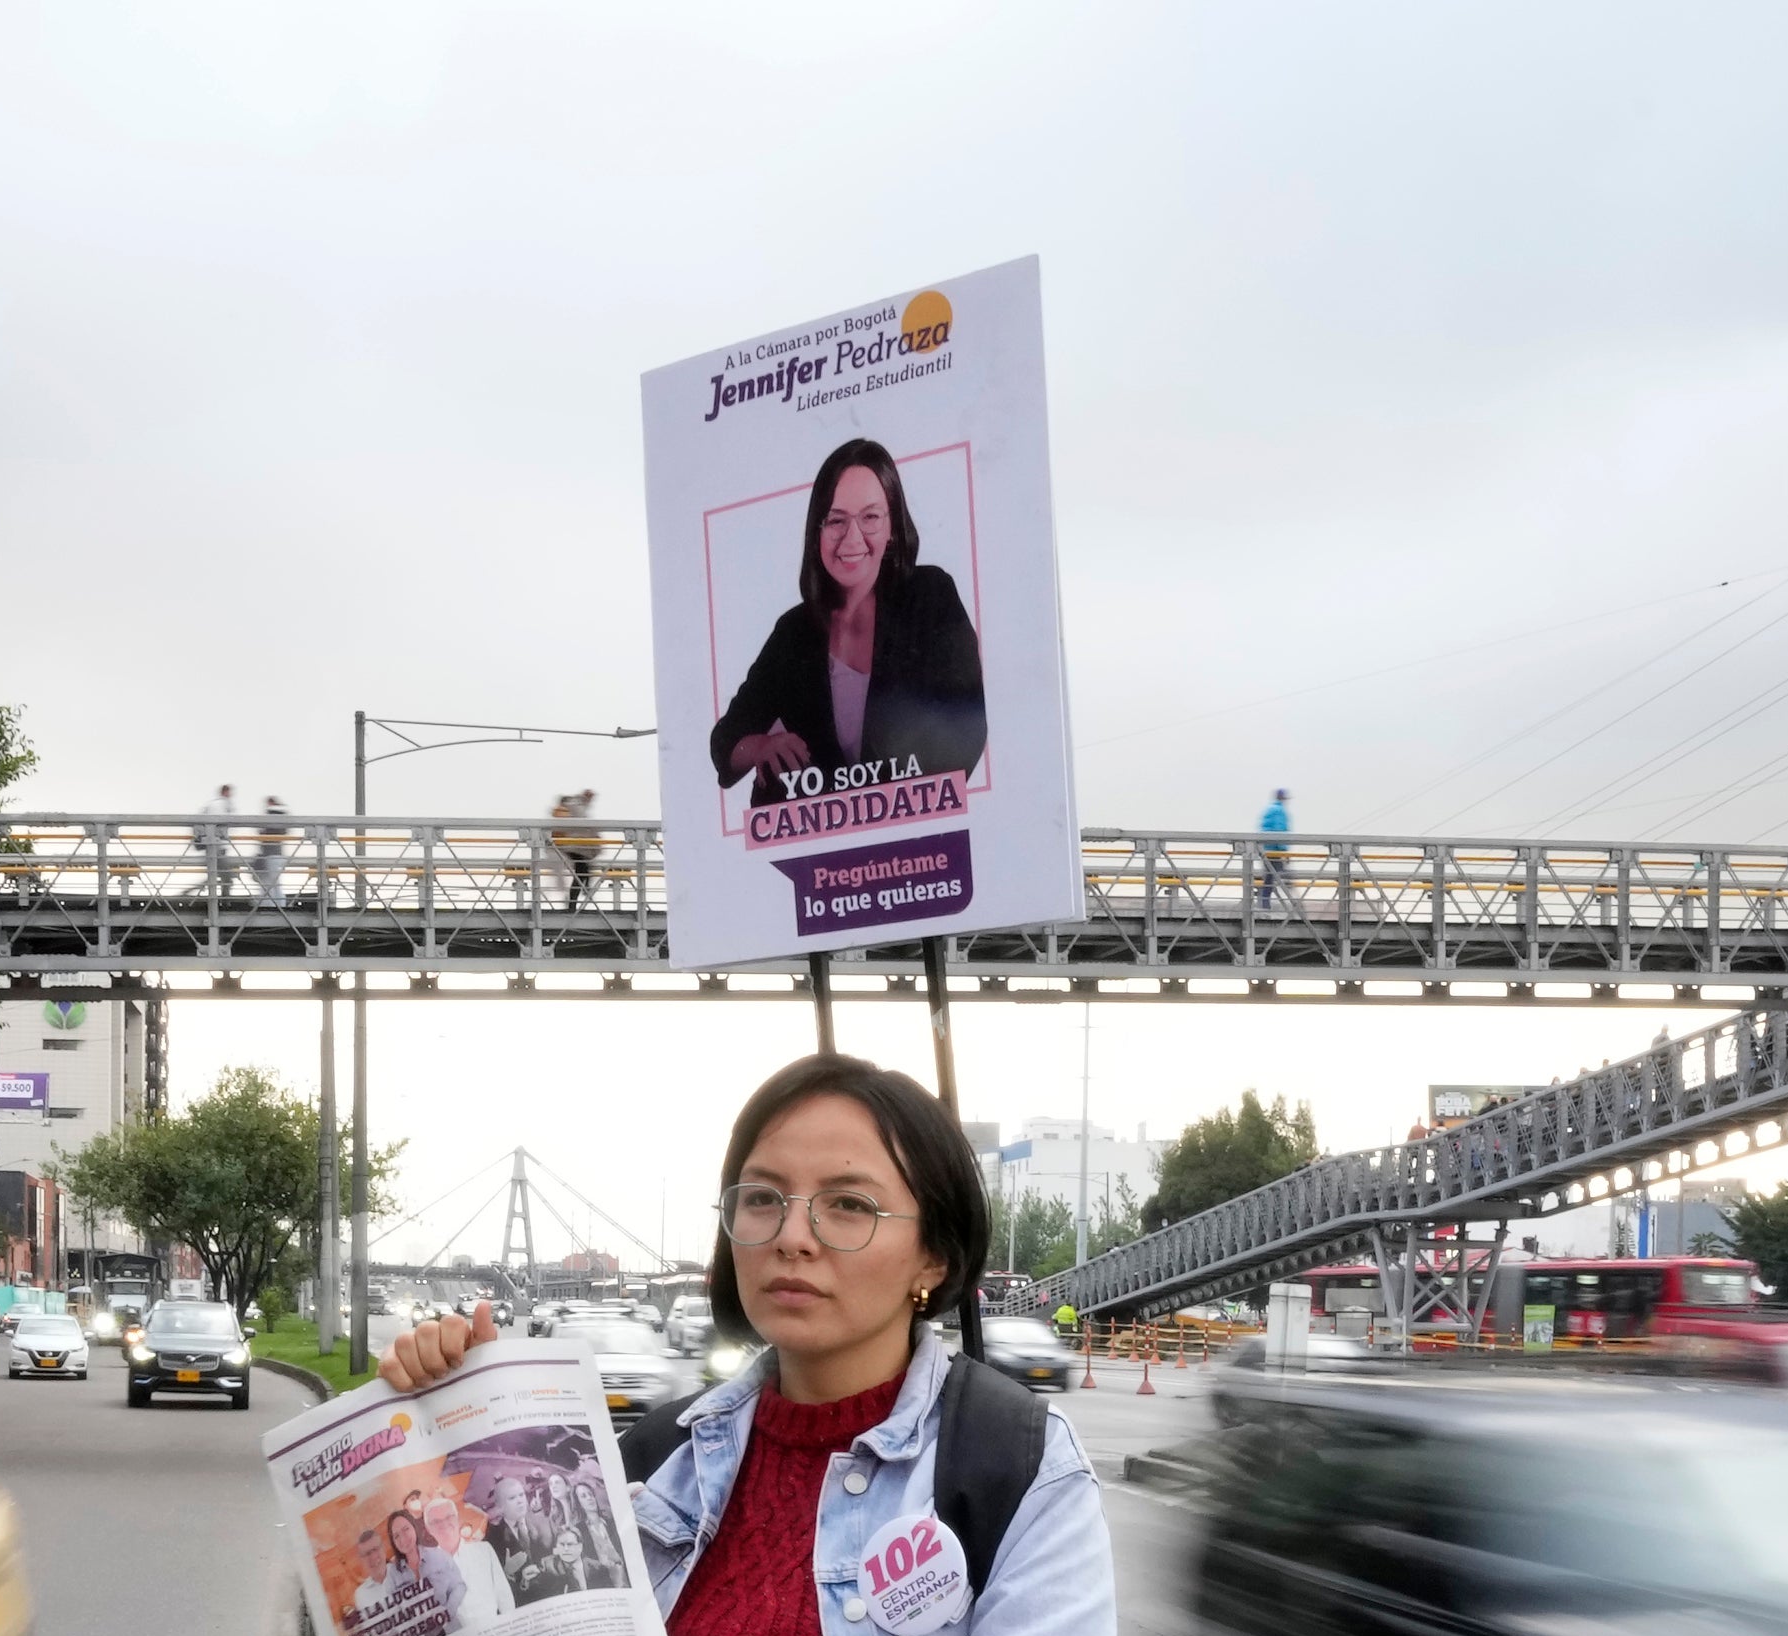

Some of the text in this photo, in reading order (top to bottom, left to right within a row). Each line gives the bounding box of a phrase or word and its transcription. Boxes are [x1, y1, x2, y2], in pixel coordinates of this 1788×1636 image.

[725, 304, 897, 370] A la Cámara por Bogotá
[704, 320, 950, 422] Jennifer Pedraza
[796, 352, 953, 412] Lideresa Estudiantil
[779, 754, 923, 800] YO SOY LA
[750, 778, 962, 843] CANDIDATA
[813, 852, 949, 890] Pregúntame
[803, 878, 963, 918] lo que quieras
[341, 1424, 406, 1480] DIGNA
[864, 1517, 943, 1597] 102
[365, 1601, 385, 1620] LA
[385, 1576, 434, 1610] LUCHA
[881, 1570, 937, 1610] CENTRO
[885, 1570, 960, 1621] ESPERANZA
